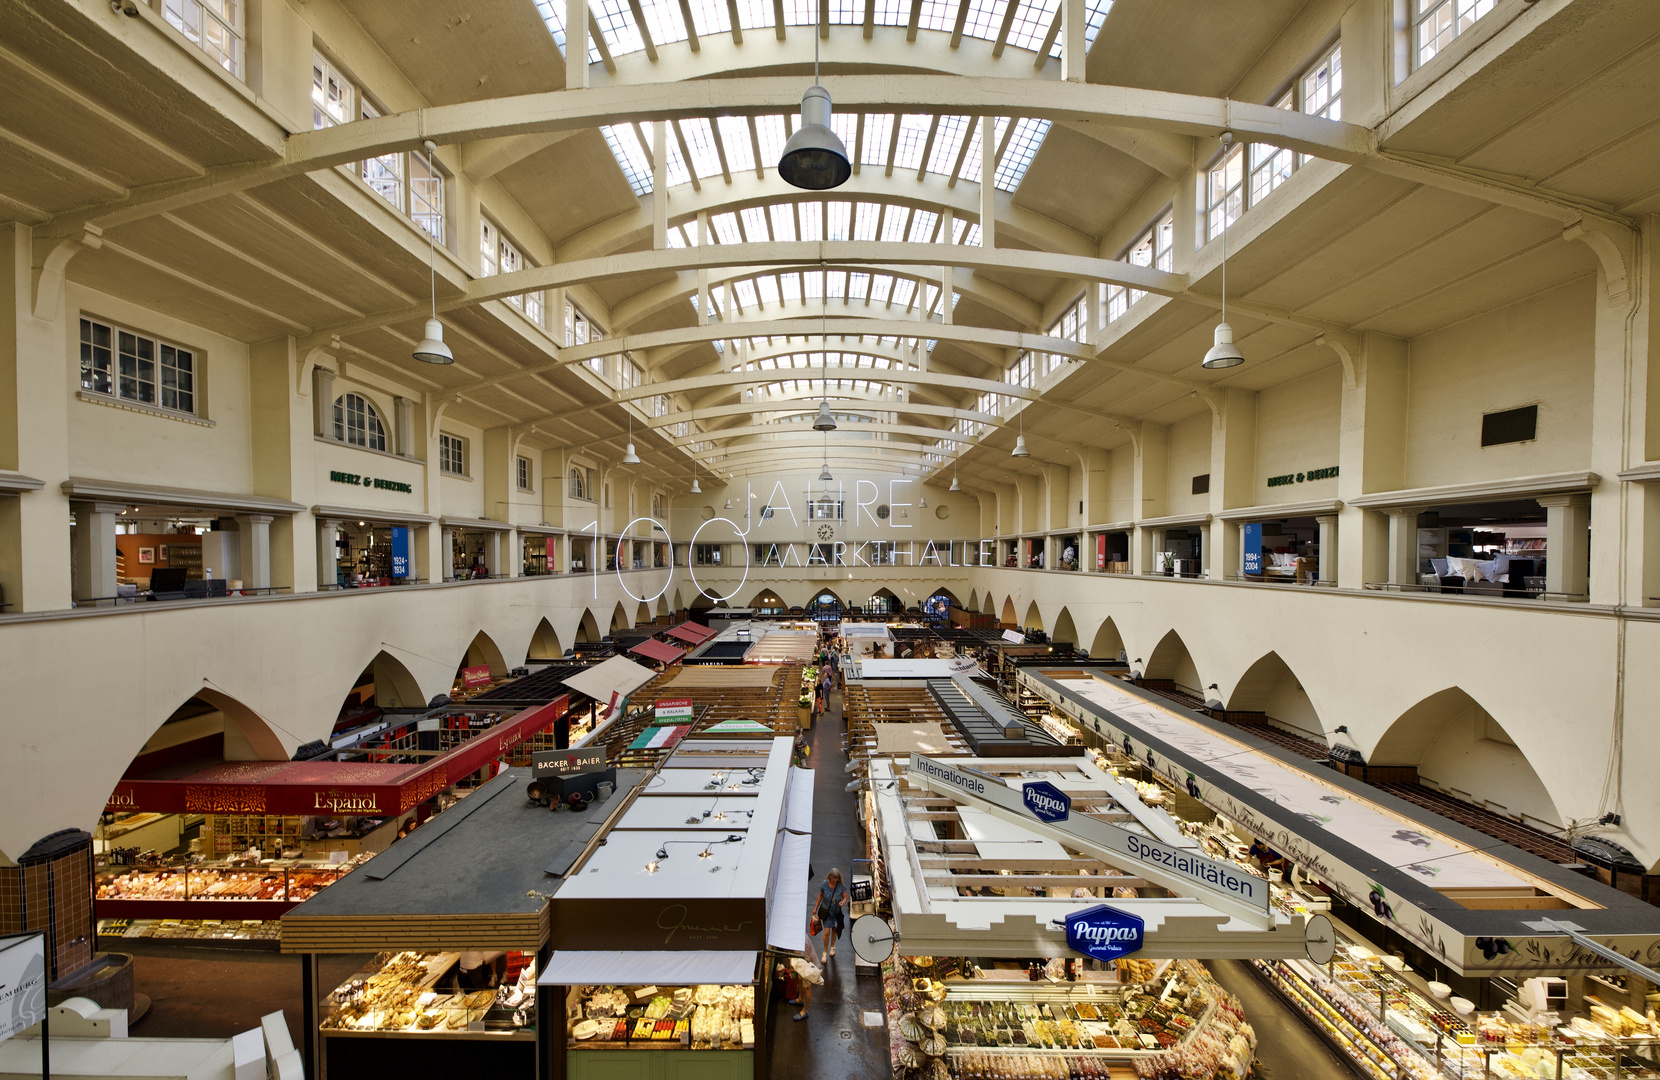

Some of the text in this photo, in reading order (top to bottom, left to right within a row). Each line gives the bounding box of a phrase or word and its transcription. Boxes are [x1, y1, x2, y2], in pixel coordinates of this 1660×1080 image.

[330, 470, 412, 494] MERZ & BENZING
[1267, 474, 1294, 487] MERZ
[1296, 472, 1305, 483] &
[733, 479, 913, 537] JAHRE
[580, 516, 750, 603] 100
[763, 539, 995, 568] MARKTHALLE
[1245, 552, 1260, 561] 1994-
[1245, 562, 1258, 571] 2004
[393, 565, 405, 574] 1934
[576, 756, 601, 766] BAIER
[916, 757, 985, 794] Internationale
[1025, 786, 1066, 813] Pappas
[1237, 806, 1275, 840] Feinkost
[1127, 835, 1253, 898] Spezialitäten
[1073, 920, 1138, 945] Pappas
